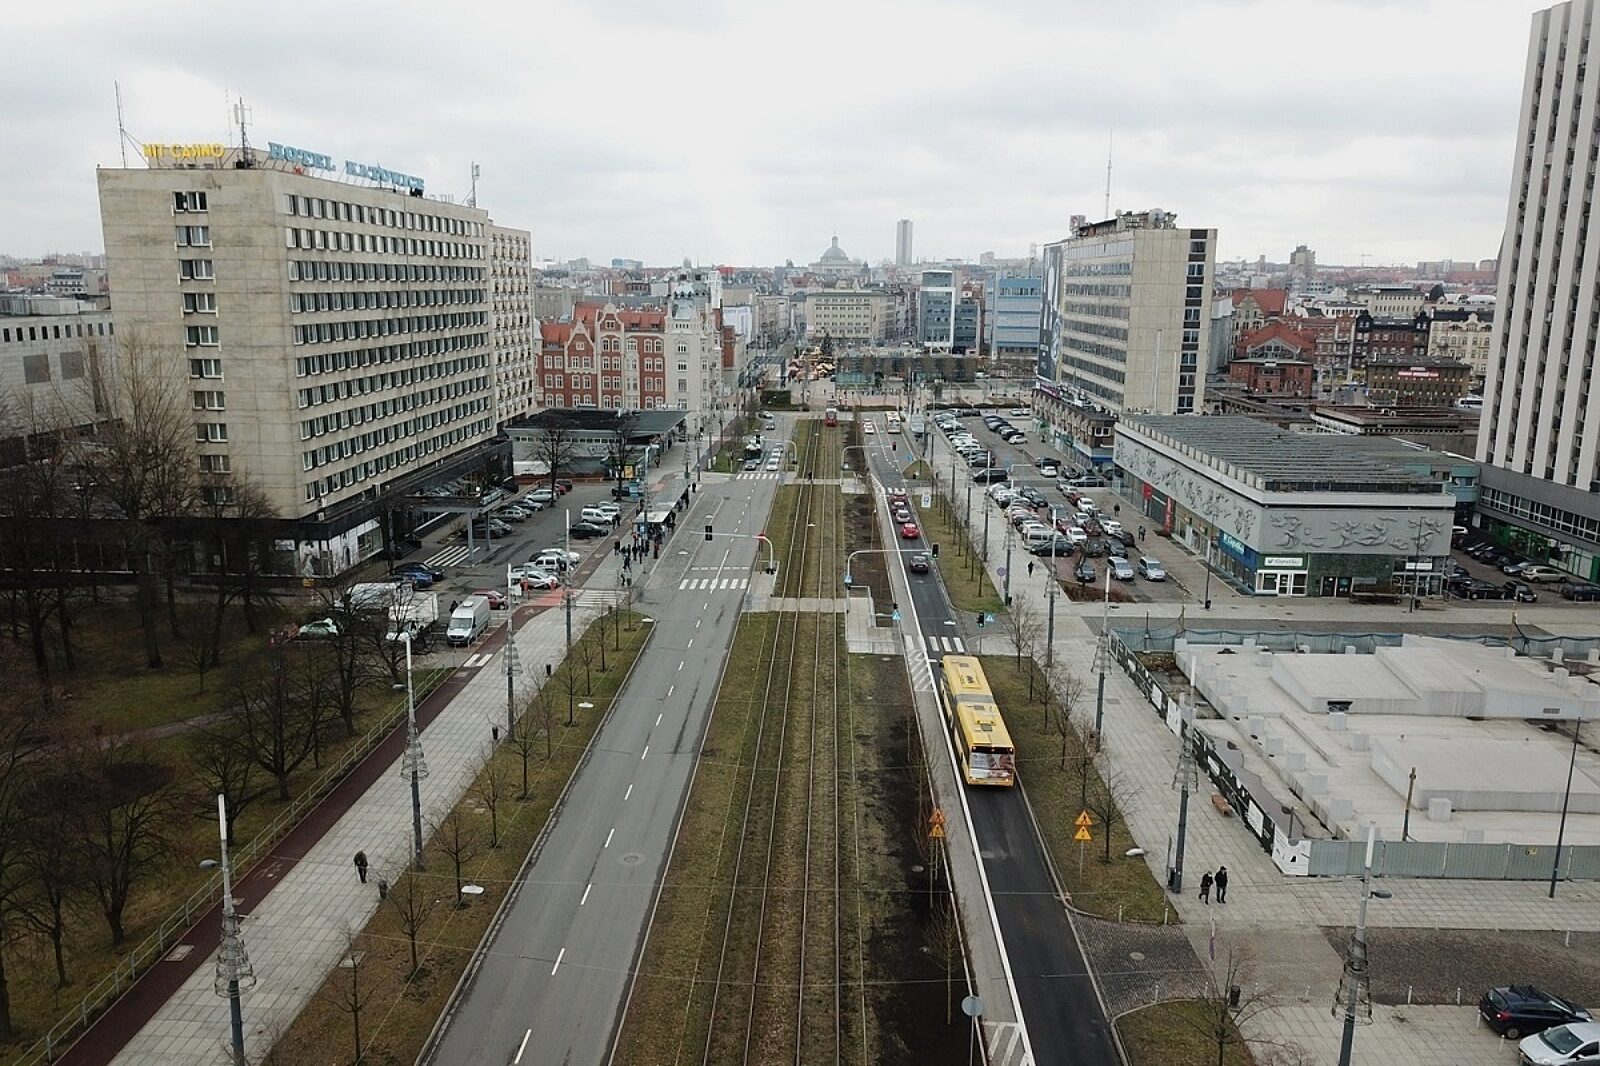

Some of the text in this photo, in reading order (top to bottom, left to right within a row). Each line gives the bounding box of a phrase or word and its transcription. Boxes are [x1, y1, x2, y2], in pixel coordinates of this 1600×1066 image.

[143, 143, 225, 158] HIT CASINO
[268, 141, 425, 191] HOTEL KATOWICE
